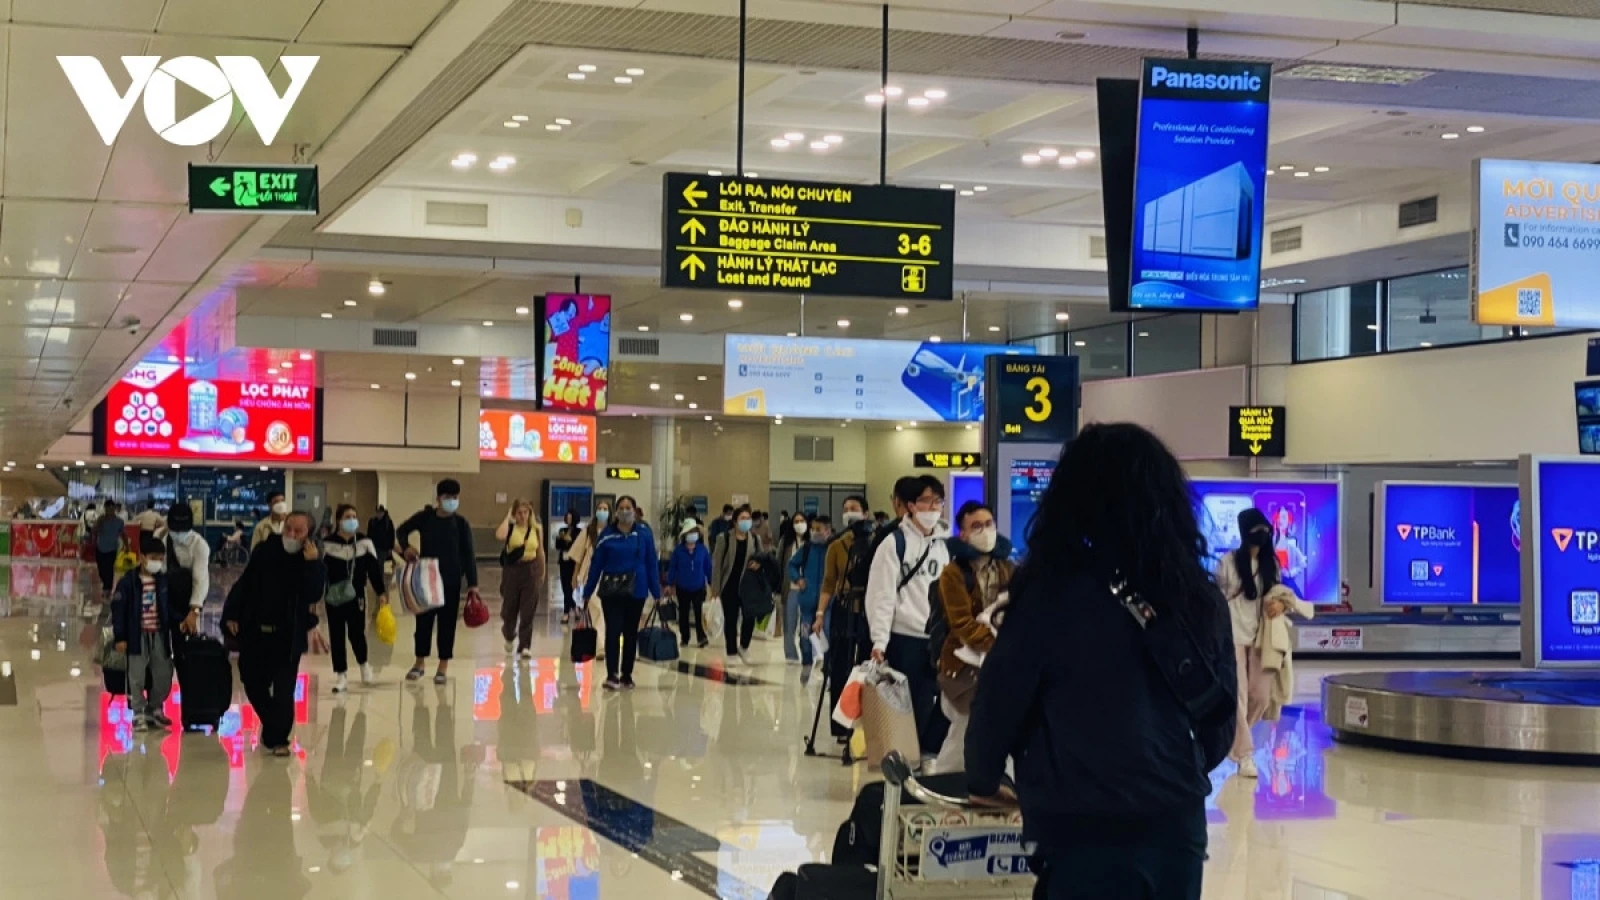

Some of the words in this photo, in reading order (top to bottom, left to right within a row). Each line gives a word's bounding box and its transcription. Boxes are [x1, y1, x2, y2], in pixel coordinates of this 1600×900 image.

[1151, 65, 1262, 92] Panasonic
[260, 173, 298, 189] EXIT
[1503, 177, 1553, 199] MỜI
[745, 184, 768, 199] RA,
[719, 199, 746, 213] Exit,
[748, 201, 798, 215] Transfer
[752, 219, 790, 236] HÀNH
[793, 221, 810, 236] LÝ
[1523, 223, 1537, 232] For
[1539, 224, 1589, 235] information
[719, 234, 771, 252] Baggage
[774, 238, 807, 251] Claim
[809, 240, 837, 253] Area
[897, 233, 932, 256] 3-6
[1522, 235, 1545, 248] 090
[1547, 236, 1569, 249] 464
[1572, 238, 1600, 250] 6699
[717, 253, 754, 270] HÀNH
[757, 255, 773, 271] LÝ
[811, 260, 837, 277] LẠC
[717, 270, 745, 284] Lost
[747, 274, 769, 286] and
[772, 273, 812, 288] Found
[241, 383, 269, 400] LỌC
[1024, 376, 1052, 422] 3
[1005, 423, 1021, 434] Belt
[1413, 526, 1456, 540] TPBank
